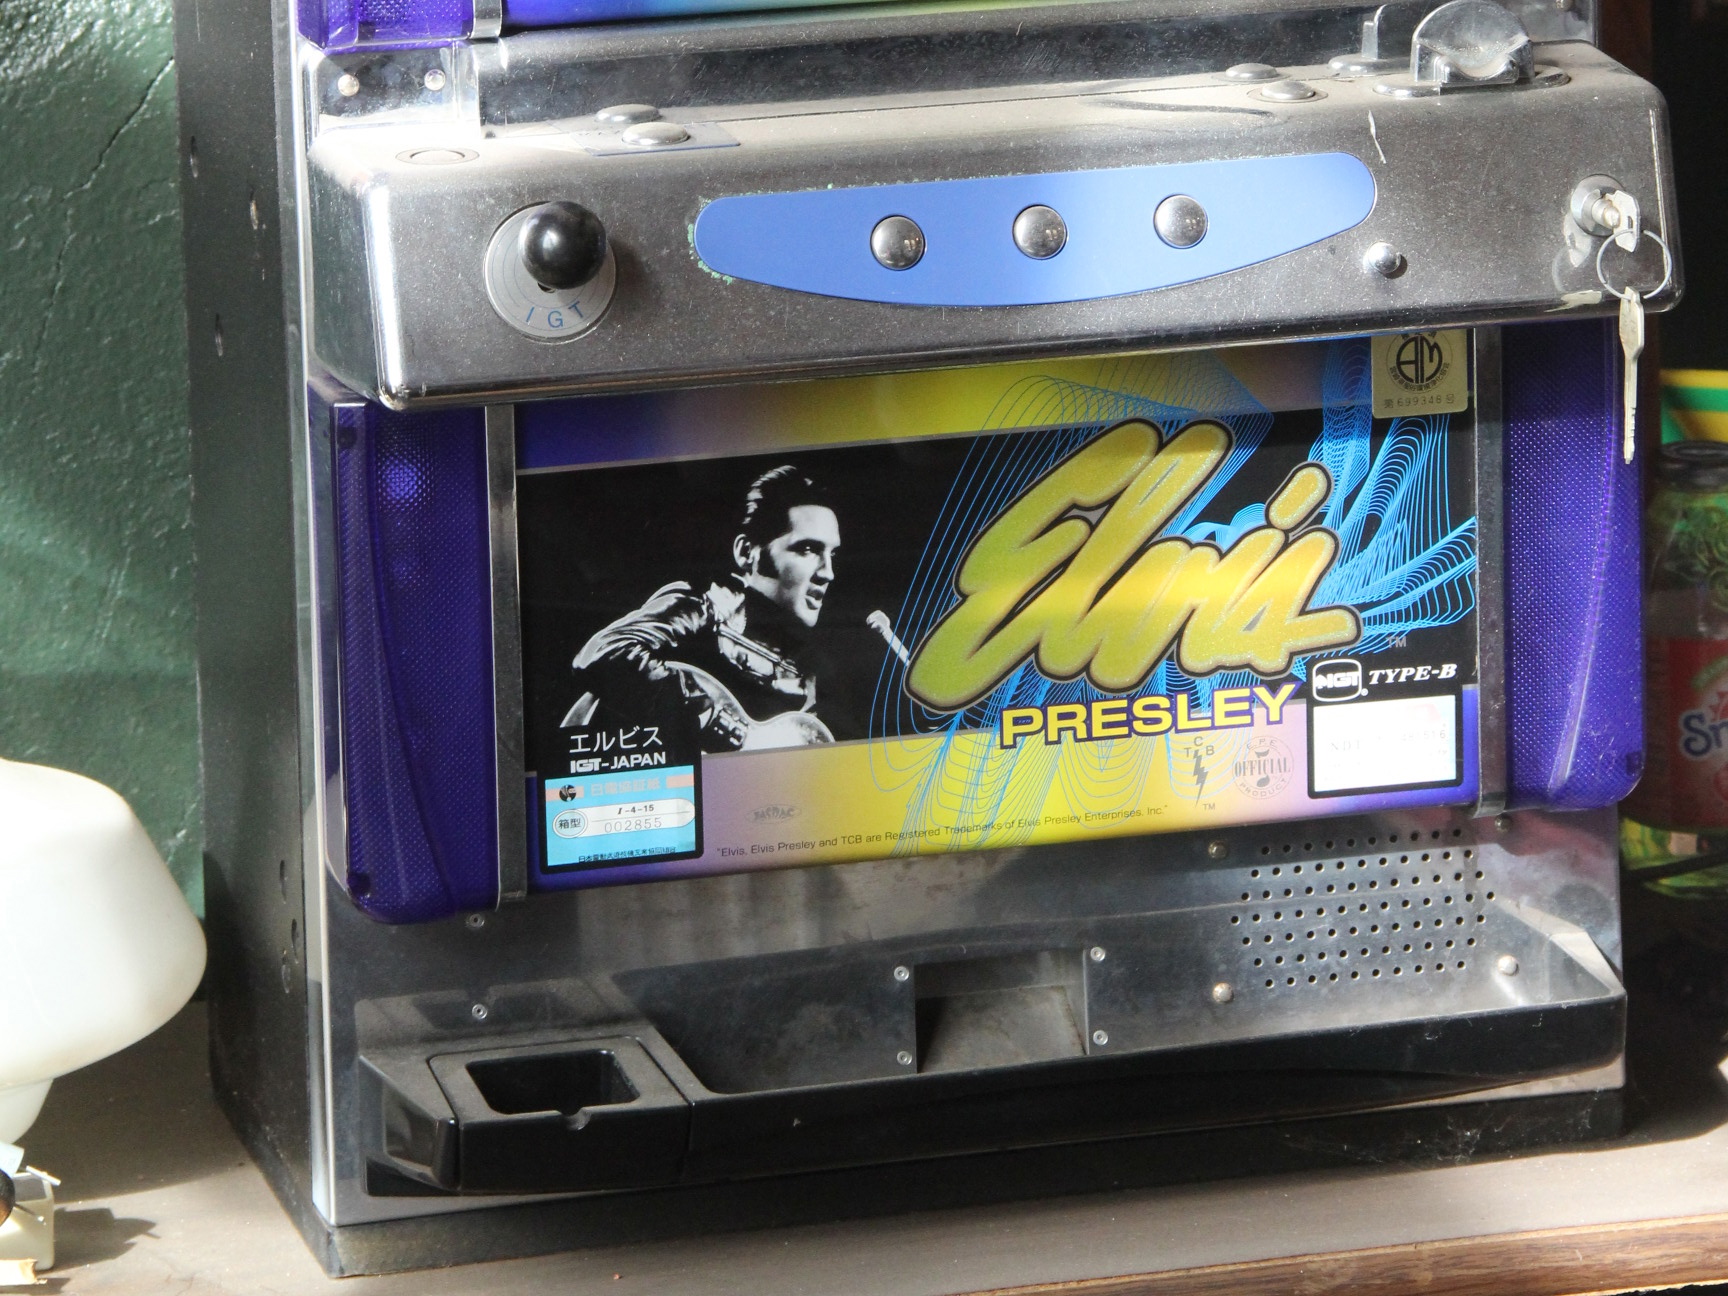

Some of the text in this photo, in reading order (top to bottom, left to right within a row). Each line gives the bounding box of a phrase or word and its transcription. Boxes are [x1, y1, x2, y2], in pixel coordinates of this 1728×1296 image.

[526, 301, 584, 328] IGT
[904, 418, 1363, 711] Elvis
[1369, 664, 1458, 684] TYPE-B
[1001, 681, 1300, 749] PRESLEY
[569, 725, 663, 753] エルビス
[570, 751, 667, 774] IGT-JAPAN
[1235, 757, 1291, 777] OFFICIAL
[558, 818, 581, 830] 箱型
[604, 817, 662, 833] 002855
[751, 844, 775, 854] Elvis
[778, 840, 817, 853] Presley
[819, 837, 838, 848] and
[840, 834, 862, 846] TCB
[866, 834, 882, 843] are
[885, 827, 941, 842] Registered
[944, 822, 1002, 835] Trademarks
[1005, 820, 1015, 829] of
[1018, 817, 1041, 828] Elvis
[1044, 815, 1081, 827] Presley
